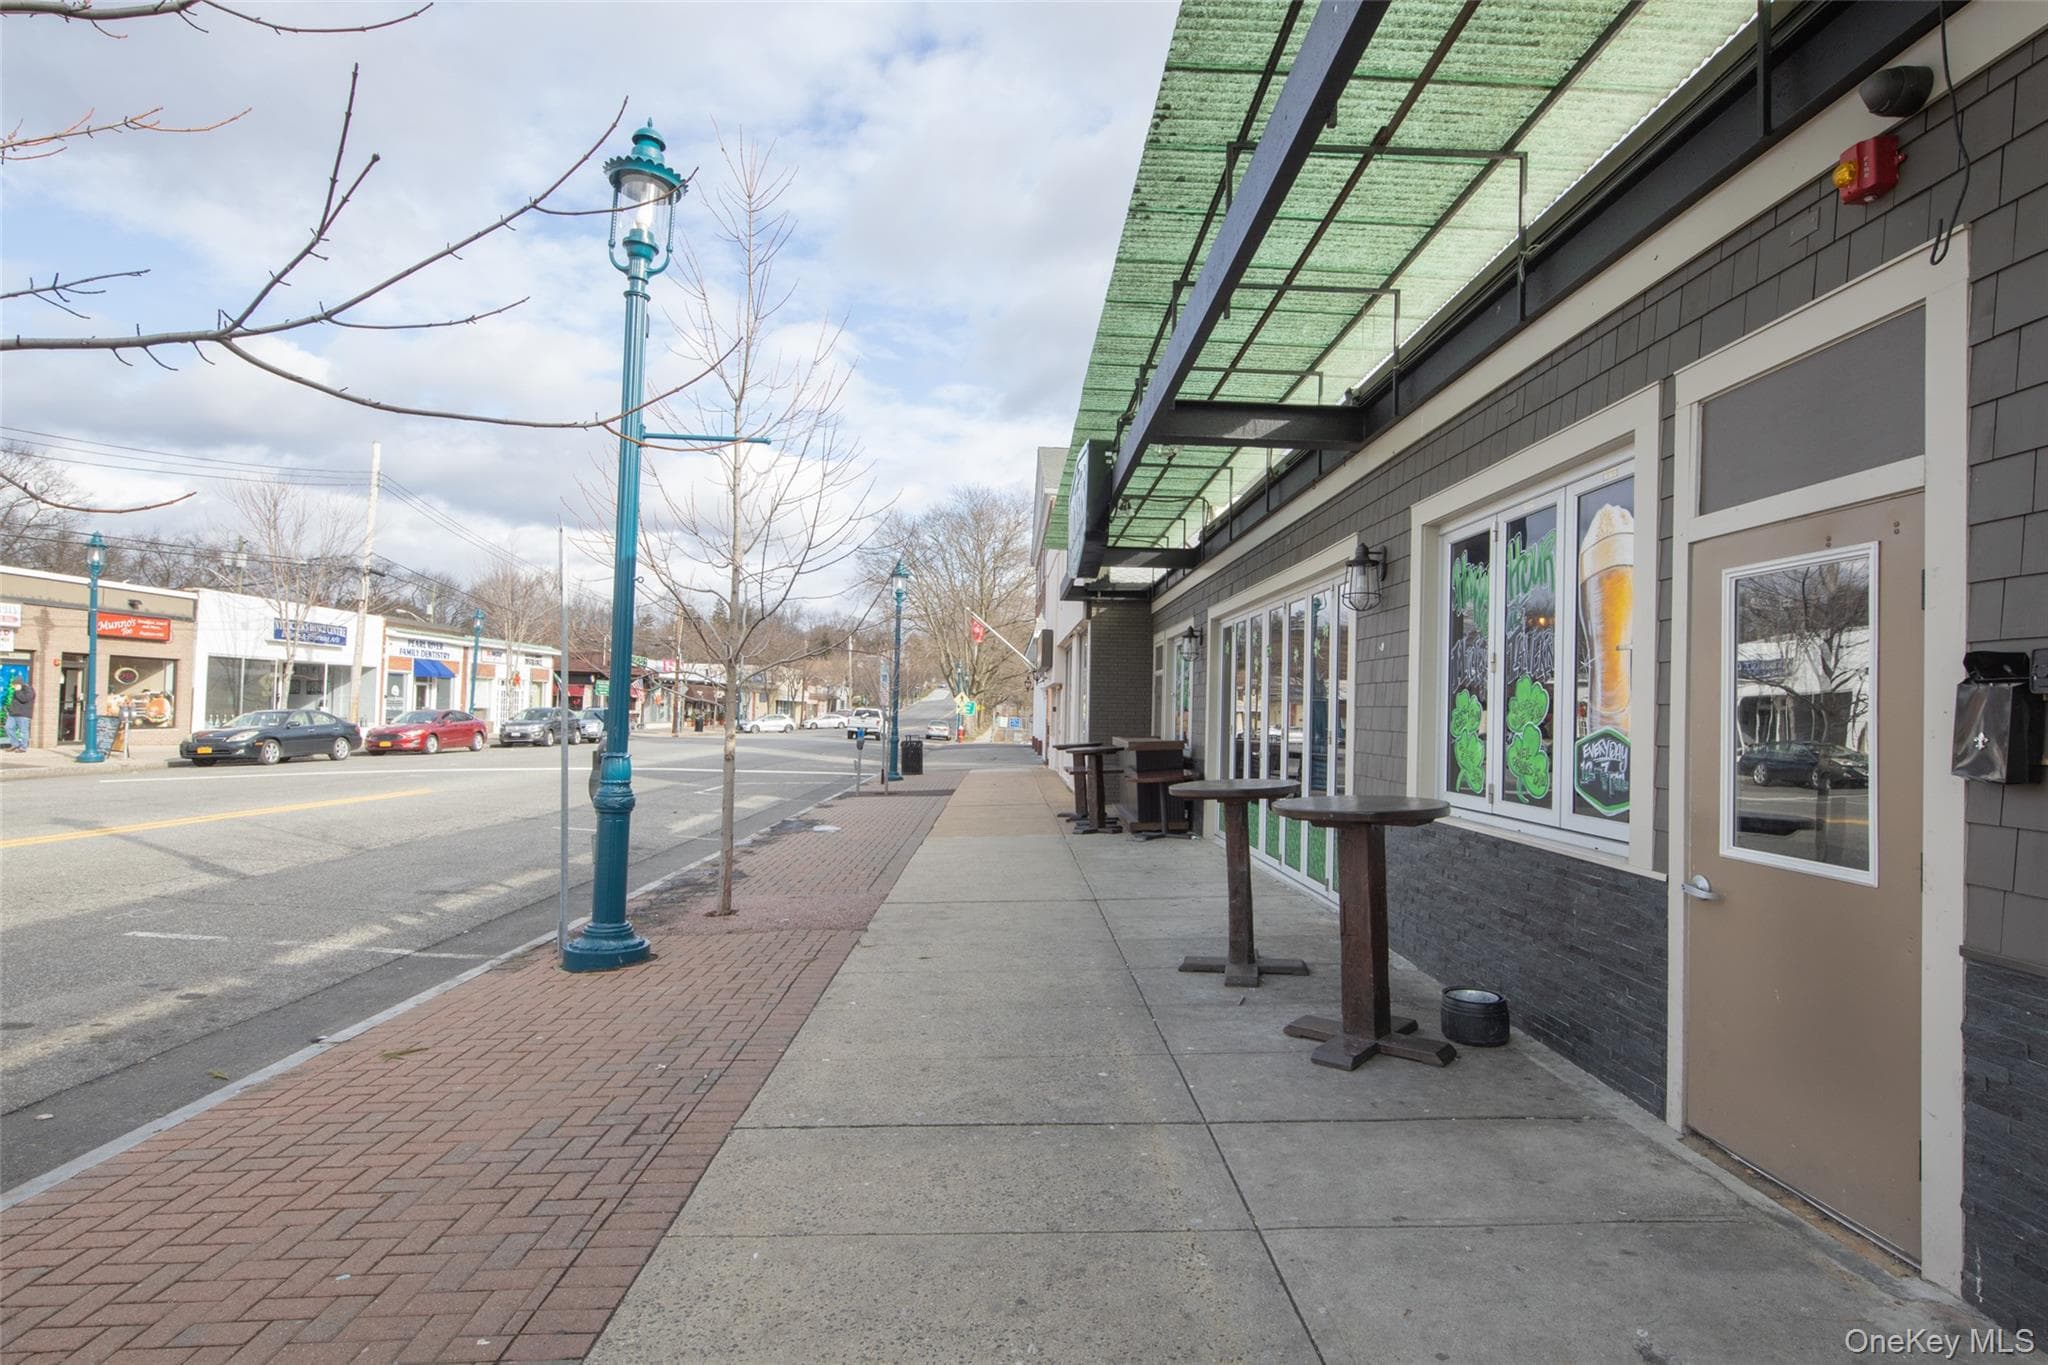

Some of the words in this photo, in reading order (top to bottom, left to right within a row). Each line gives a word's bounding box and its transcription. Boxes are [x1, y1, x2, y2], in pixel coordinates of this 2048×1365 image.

[1507, 529, 1557, 603] Hour
[400, 648, 419, 657] FAMILY
[421, 650, 450, 660] DENTISTRY
[1583, 739, 1629, 773] EVERYDAY
